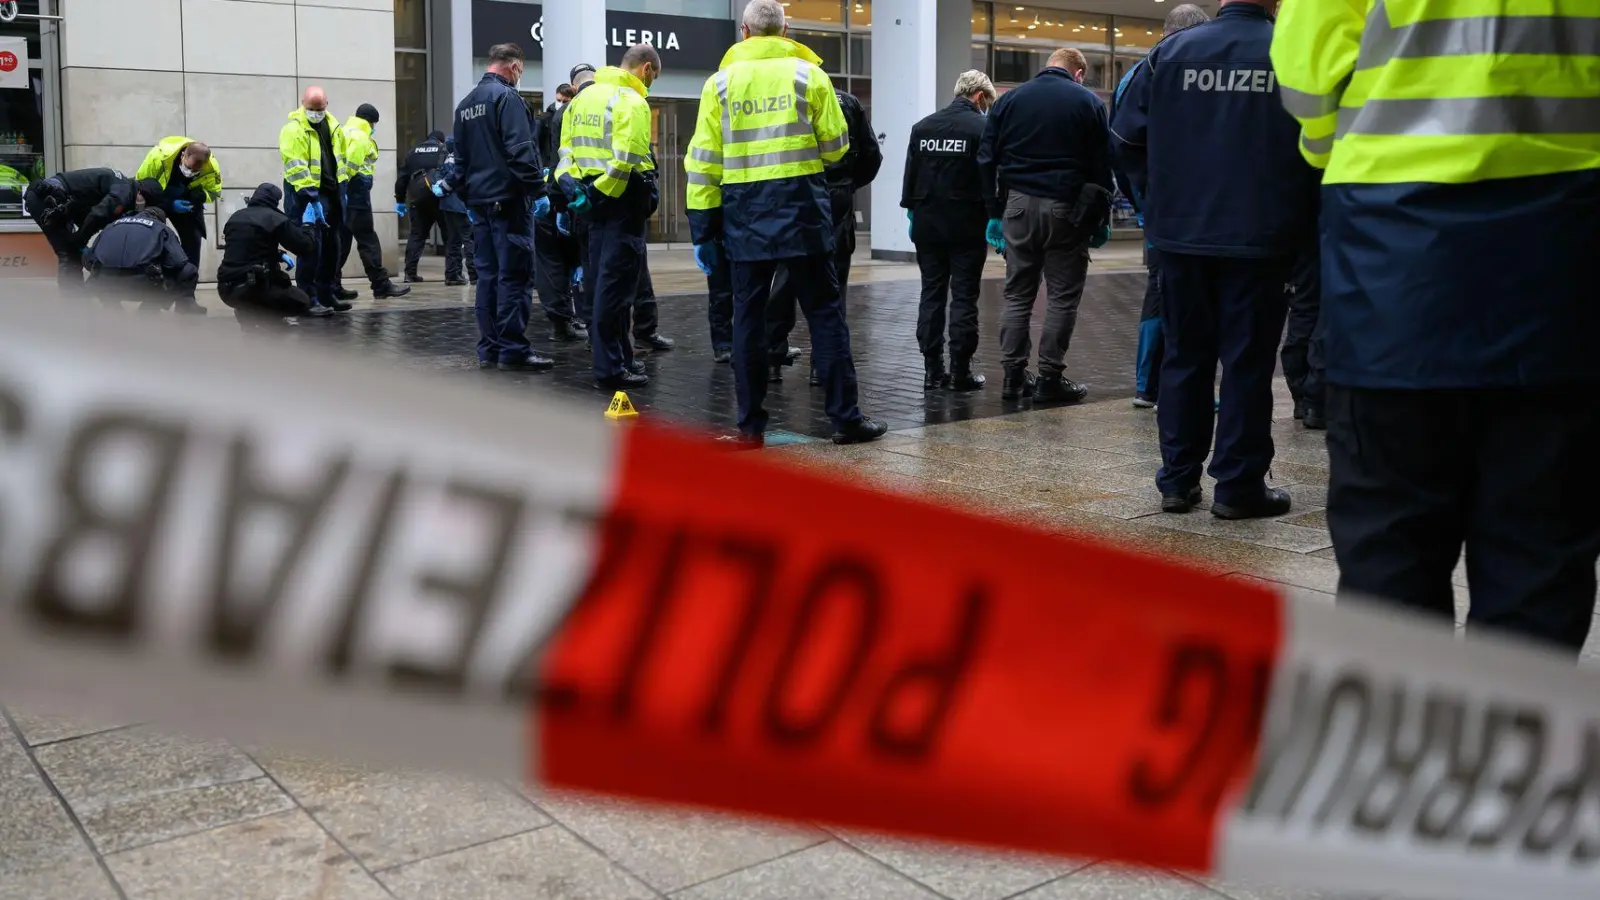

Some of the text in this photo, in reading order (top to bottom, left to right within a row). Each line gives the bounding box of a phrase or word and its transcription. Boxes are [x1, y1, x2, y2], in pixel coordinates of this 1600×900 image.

[604, 27, 681, 50] LERIA
[1182, 68, 1275, 93] POLIZEI
[460, 103, 486, 122] POLZEI
[732, 93, 792, 116] POLIZEI
[572, 112, 602, 128] POLIZEI
[919, 139, 967, 153] POLIZEI
[0, 255, 29, 267] ZEL
[0, 376, 995, 765] POLIZEIAB
